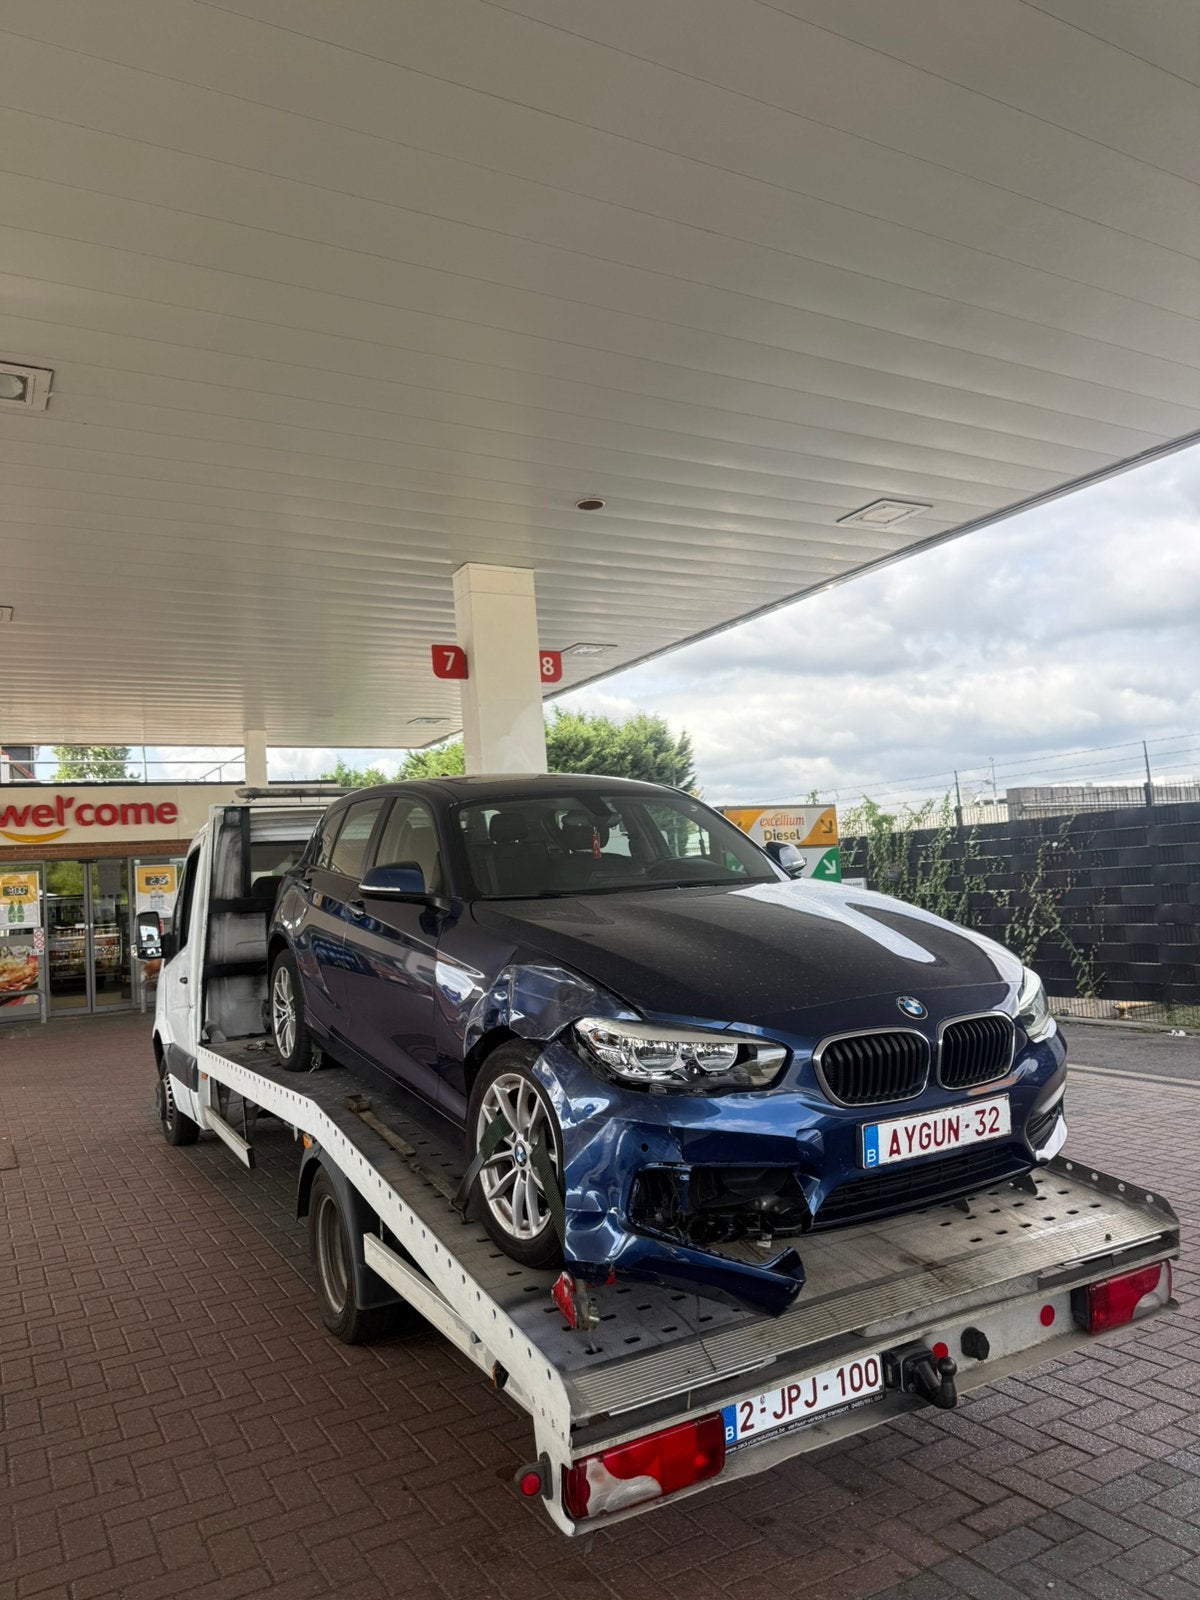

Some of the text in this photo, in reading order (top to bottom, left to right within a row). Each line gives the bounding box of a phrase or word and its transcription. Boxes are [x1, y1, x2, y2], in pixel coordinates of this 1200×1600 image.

[443, 652, 456, 671] 7
[542, 657, 555, 675] 8
[760, 813, 804, 827] excellium
[763, 829, 801, 841] Diesel
[867, 1149, 876, 1163] B
[726, 1426, 734, 1440] B
